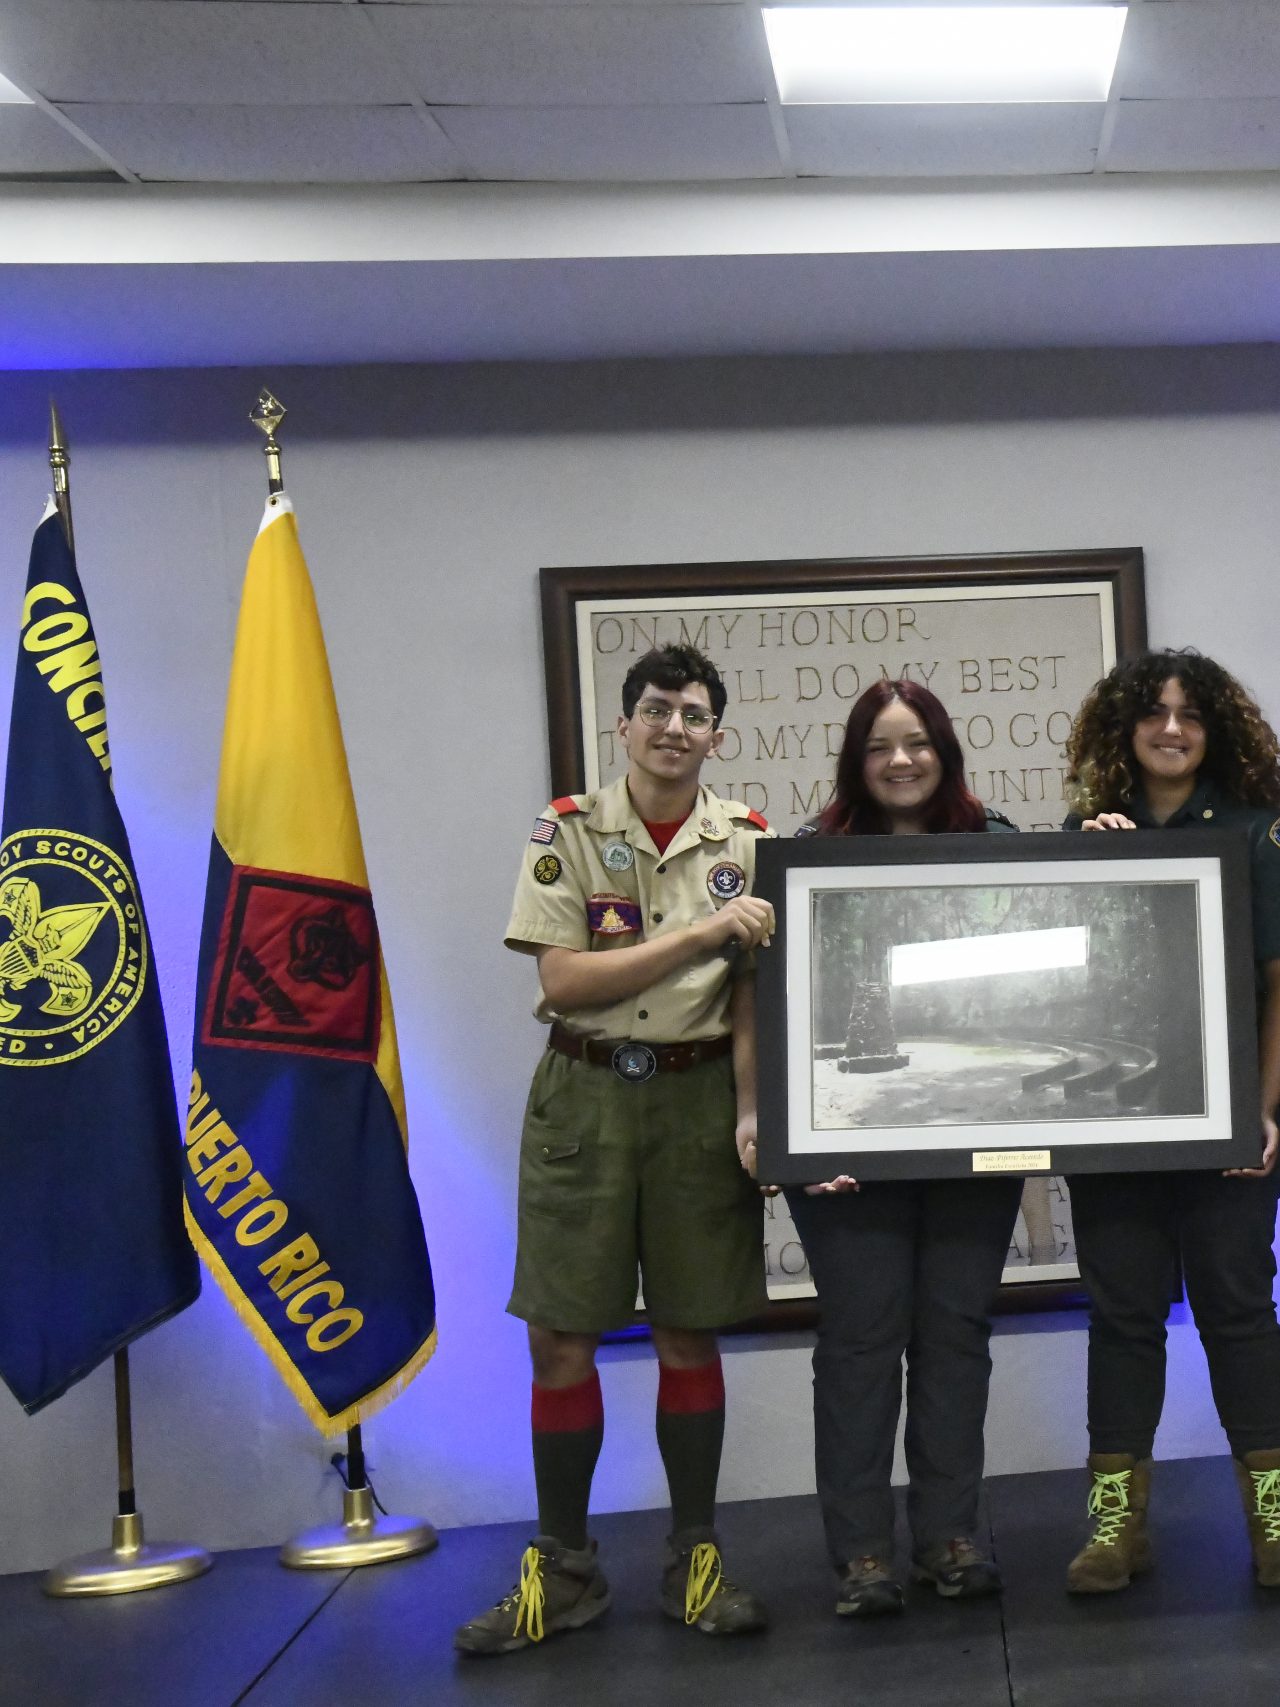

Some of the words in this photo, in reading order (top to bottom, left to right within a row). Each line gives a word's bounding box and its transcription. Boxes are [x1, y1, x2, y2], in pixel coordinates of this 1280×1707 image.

[596, 616, 662, 654] ON
[678, 614, 743, 650] MY
[758, 607, 932, 648] HONOR
[21, 581, 114, 795] CONCIL
[795, 663, 861, 702] DO
[960, 655, 1066, 693] BEST
[753, 724, 813, 761] MY
[1009, 711, 1073, 748] GO
[706, 782, 769, 815] ND
[0, 842, 22, 867] OY
[36, 840, 127, 894] SCOUTS
[125, 903, 139, 935] OF
[71, 946, 139, 1044] AMERICA
[257, 1232, 364, 1353] RICO
